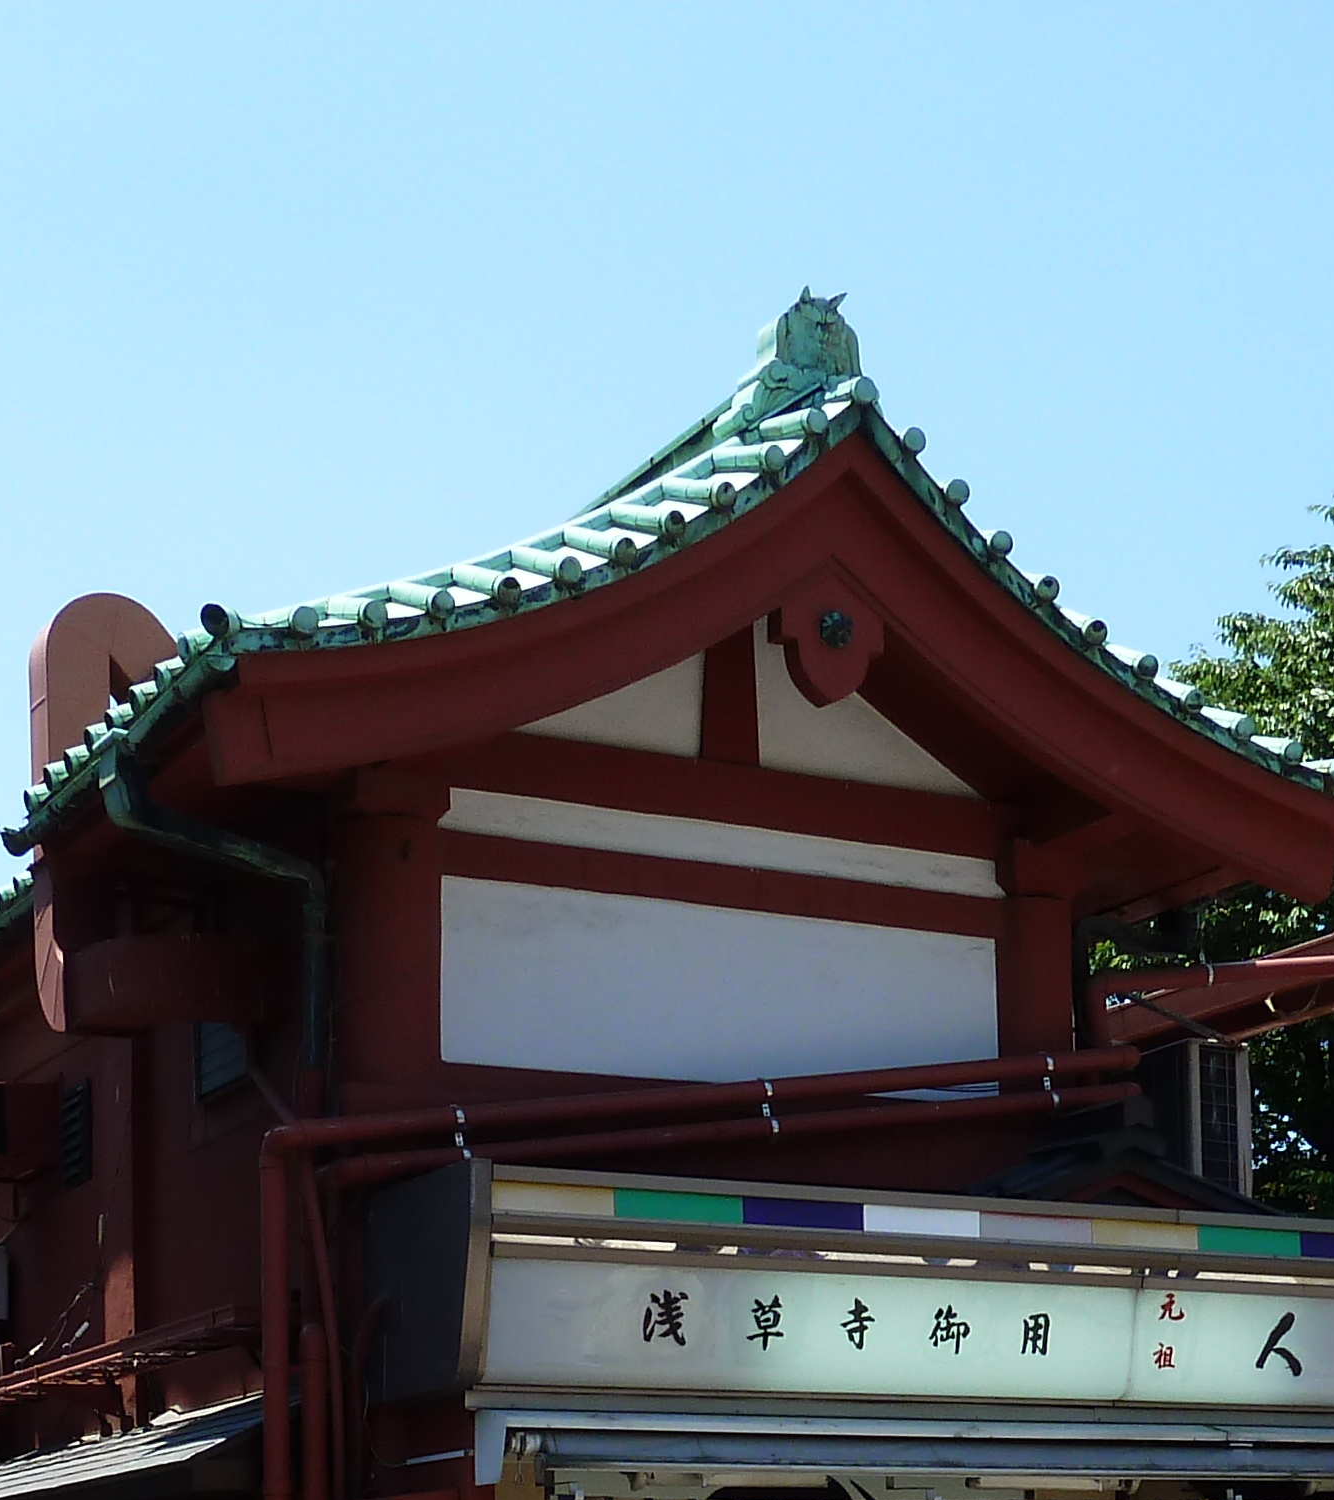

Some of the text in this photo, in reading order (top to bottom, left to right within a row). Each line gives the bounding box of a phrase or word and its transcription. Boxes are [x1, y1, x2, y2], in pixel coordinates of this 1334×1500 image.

[641, 1288, 1051, 1357] 浅草寺御用
[1153, 1293, 1185, 1371] 元祖
